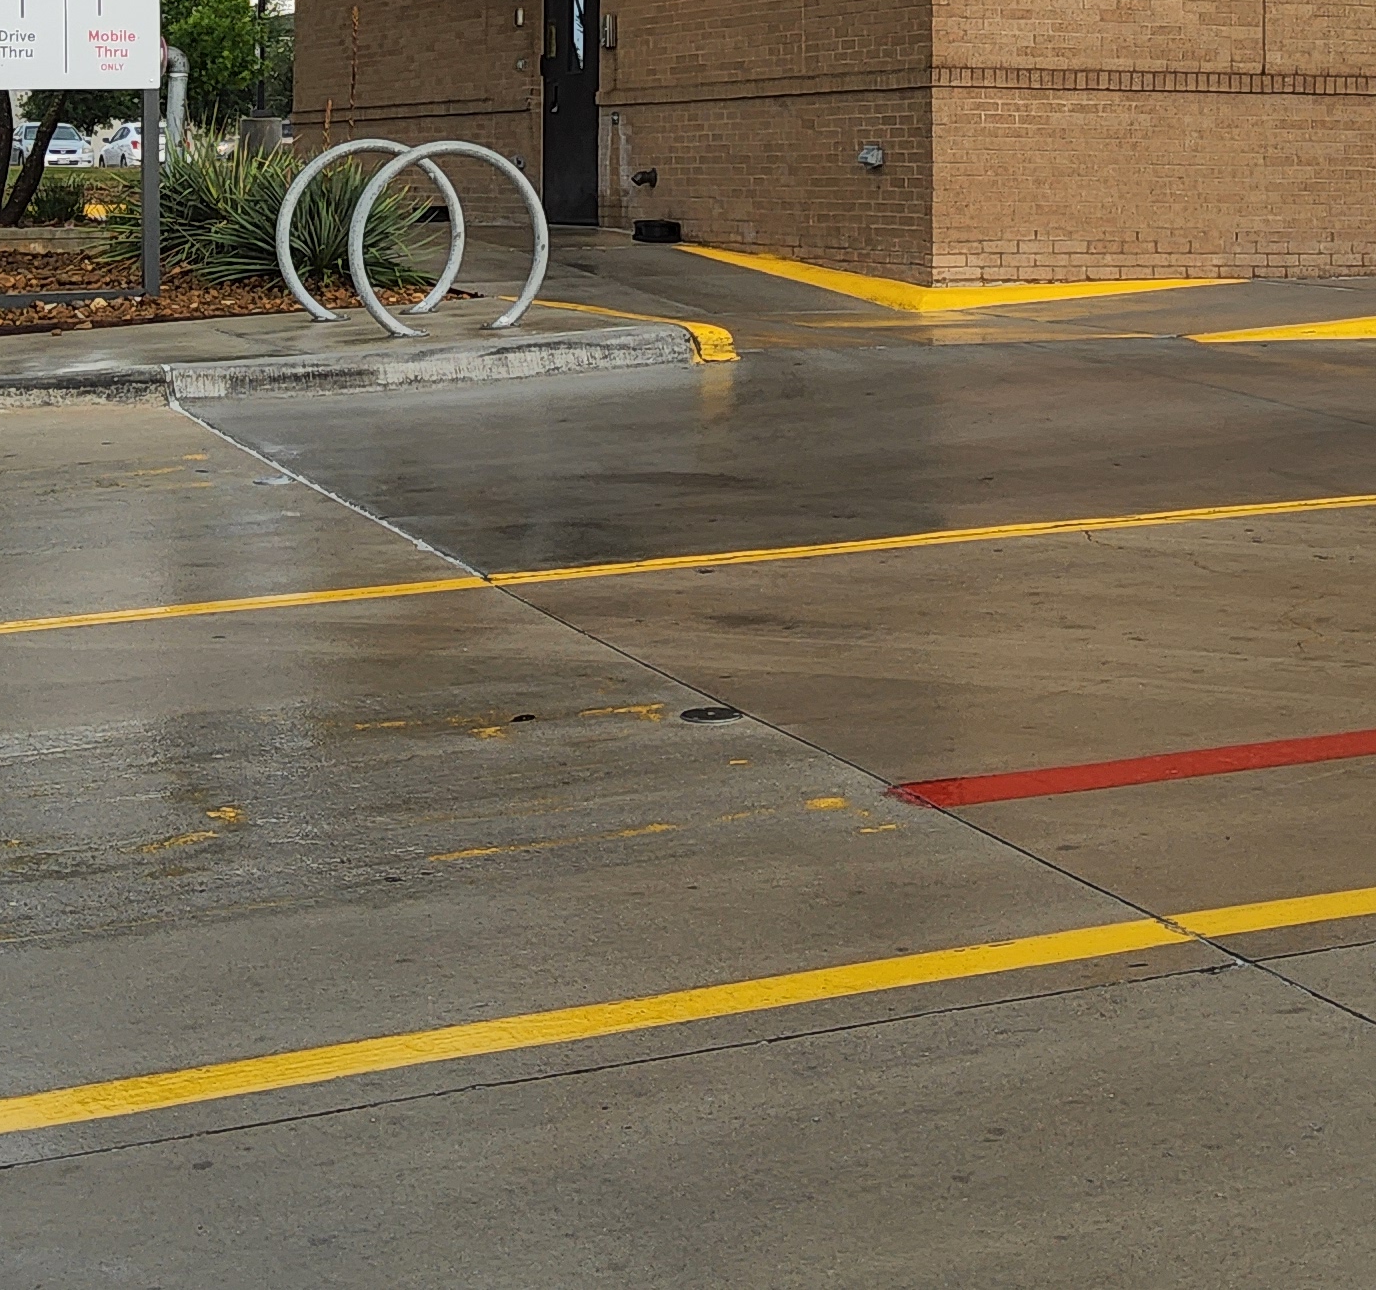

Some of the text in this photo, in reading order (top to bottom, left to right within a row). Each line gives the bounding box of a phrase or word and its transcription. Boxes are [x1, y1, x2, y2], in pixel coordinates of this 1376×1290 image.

[88, 29, 136, 43] Mobile
[0, 45, 34, 58] Thru
[95, 45, 129, 58] Thru
[100, 62, 125, 71] ONLY
